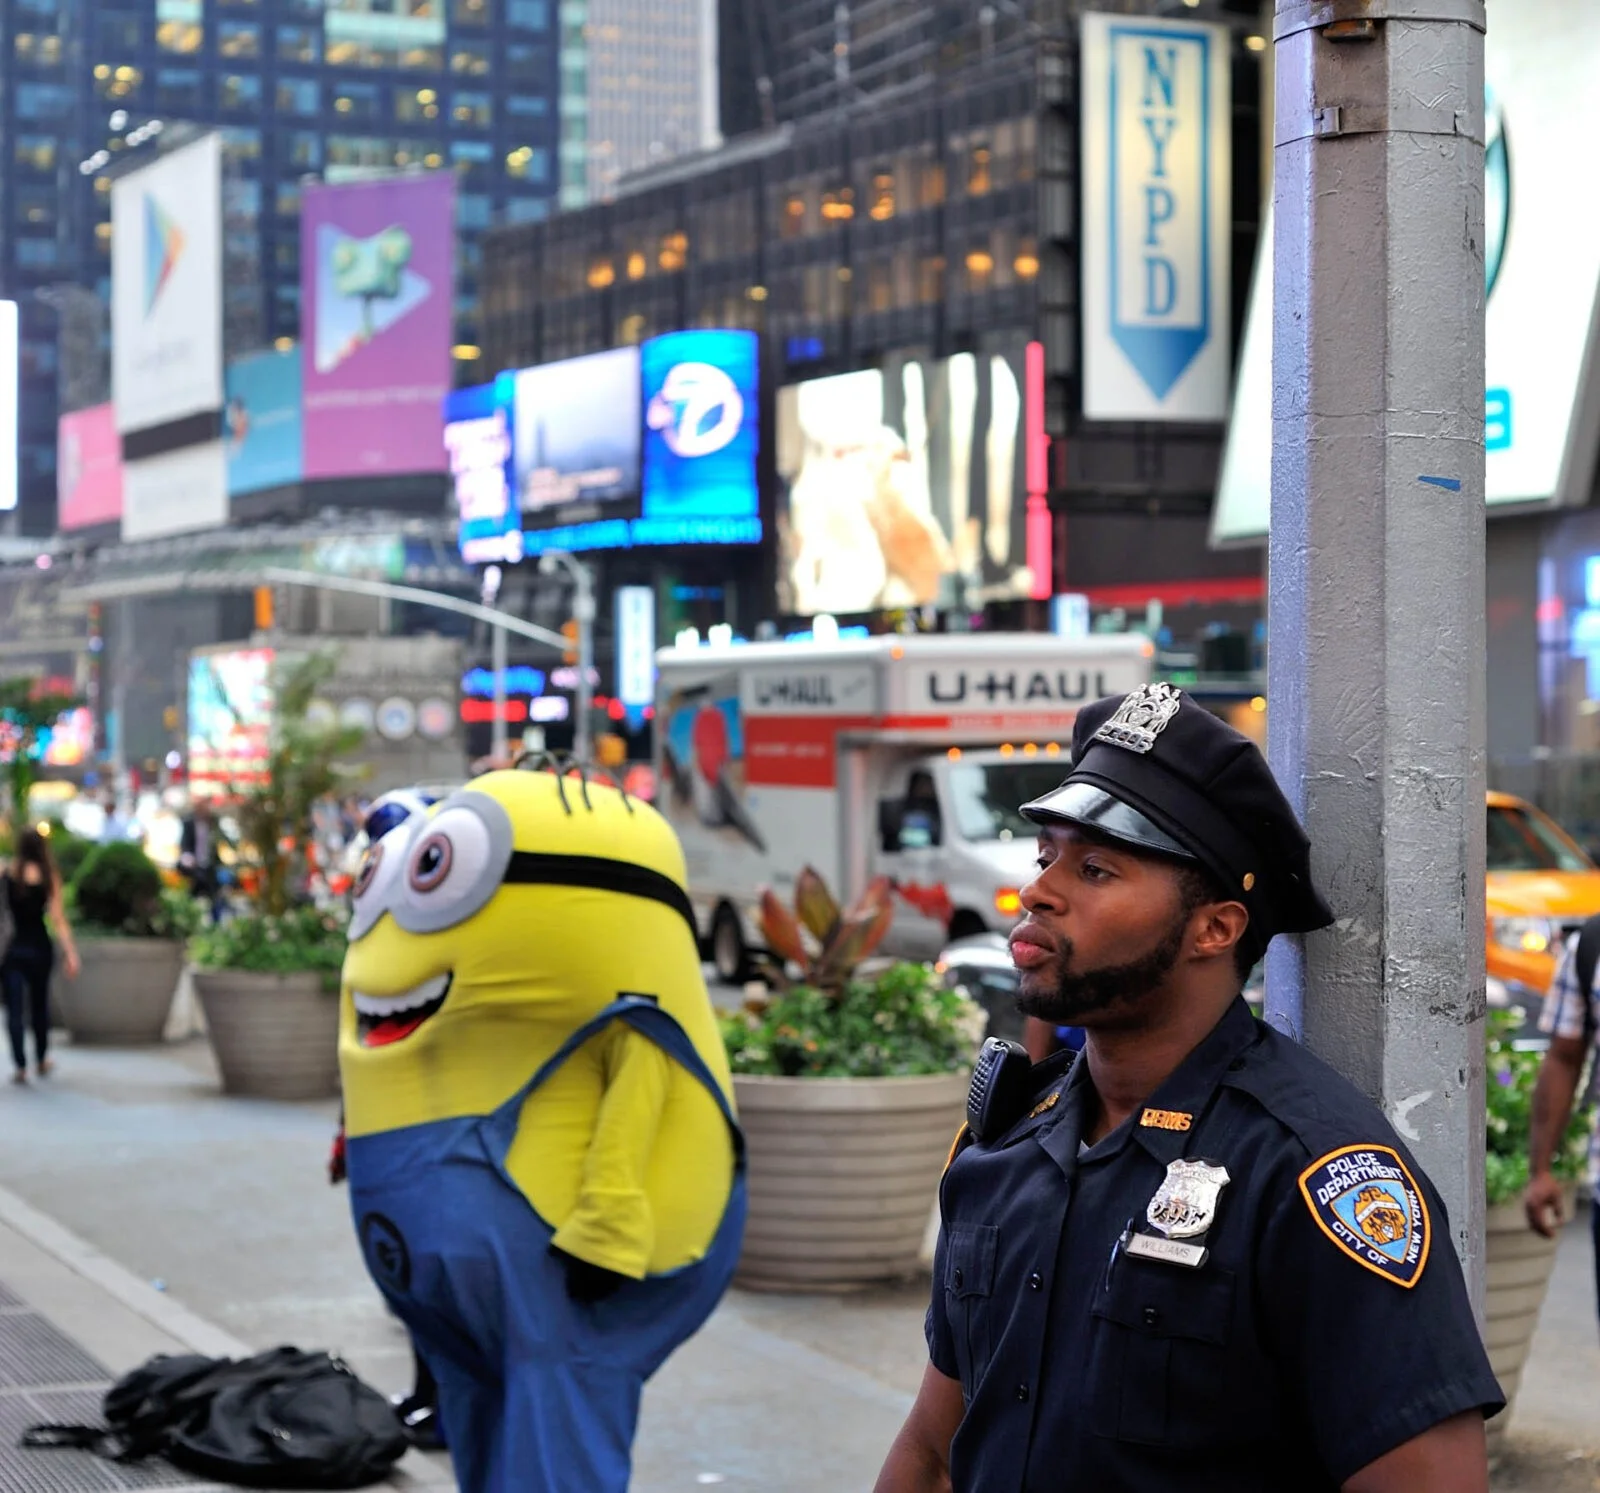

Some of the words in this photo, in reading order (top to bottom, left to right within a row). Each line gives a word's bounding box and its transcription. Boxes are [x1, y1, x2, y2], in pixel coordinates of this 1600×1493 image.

[1142, 46, 1178, 317] NYPD
[1326, 1152, 1381, 1178] POLICE
[1316, 1165, 1404, 1206] DEPARTMENT
[1405, 1189, 1422, 1226] YORK
[1141, 1240, 1191, 1258] WILLIAMS
[1332, 1221, 1366, 1251] CITY
[1366, 1249, 1390, 1265] OF
[1406, 1231, 1422, 1264] NEW
